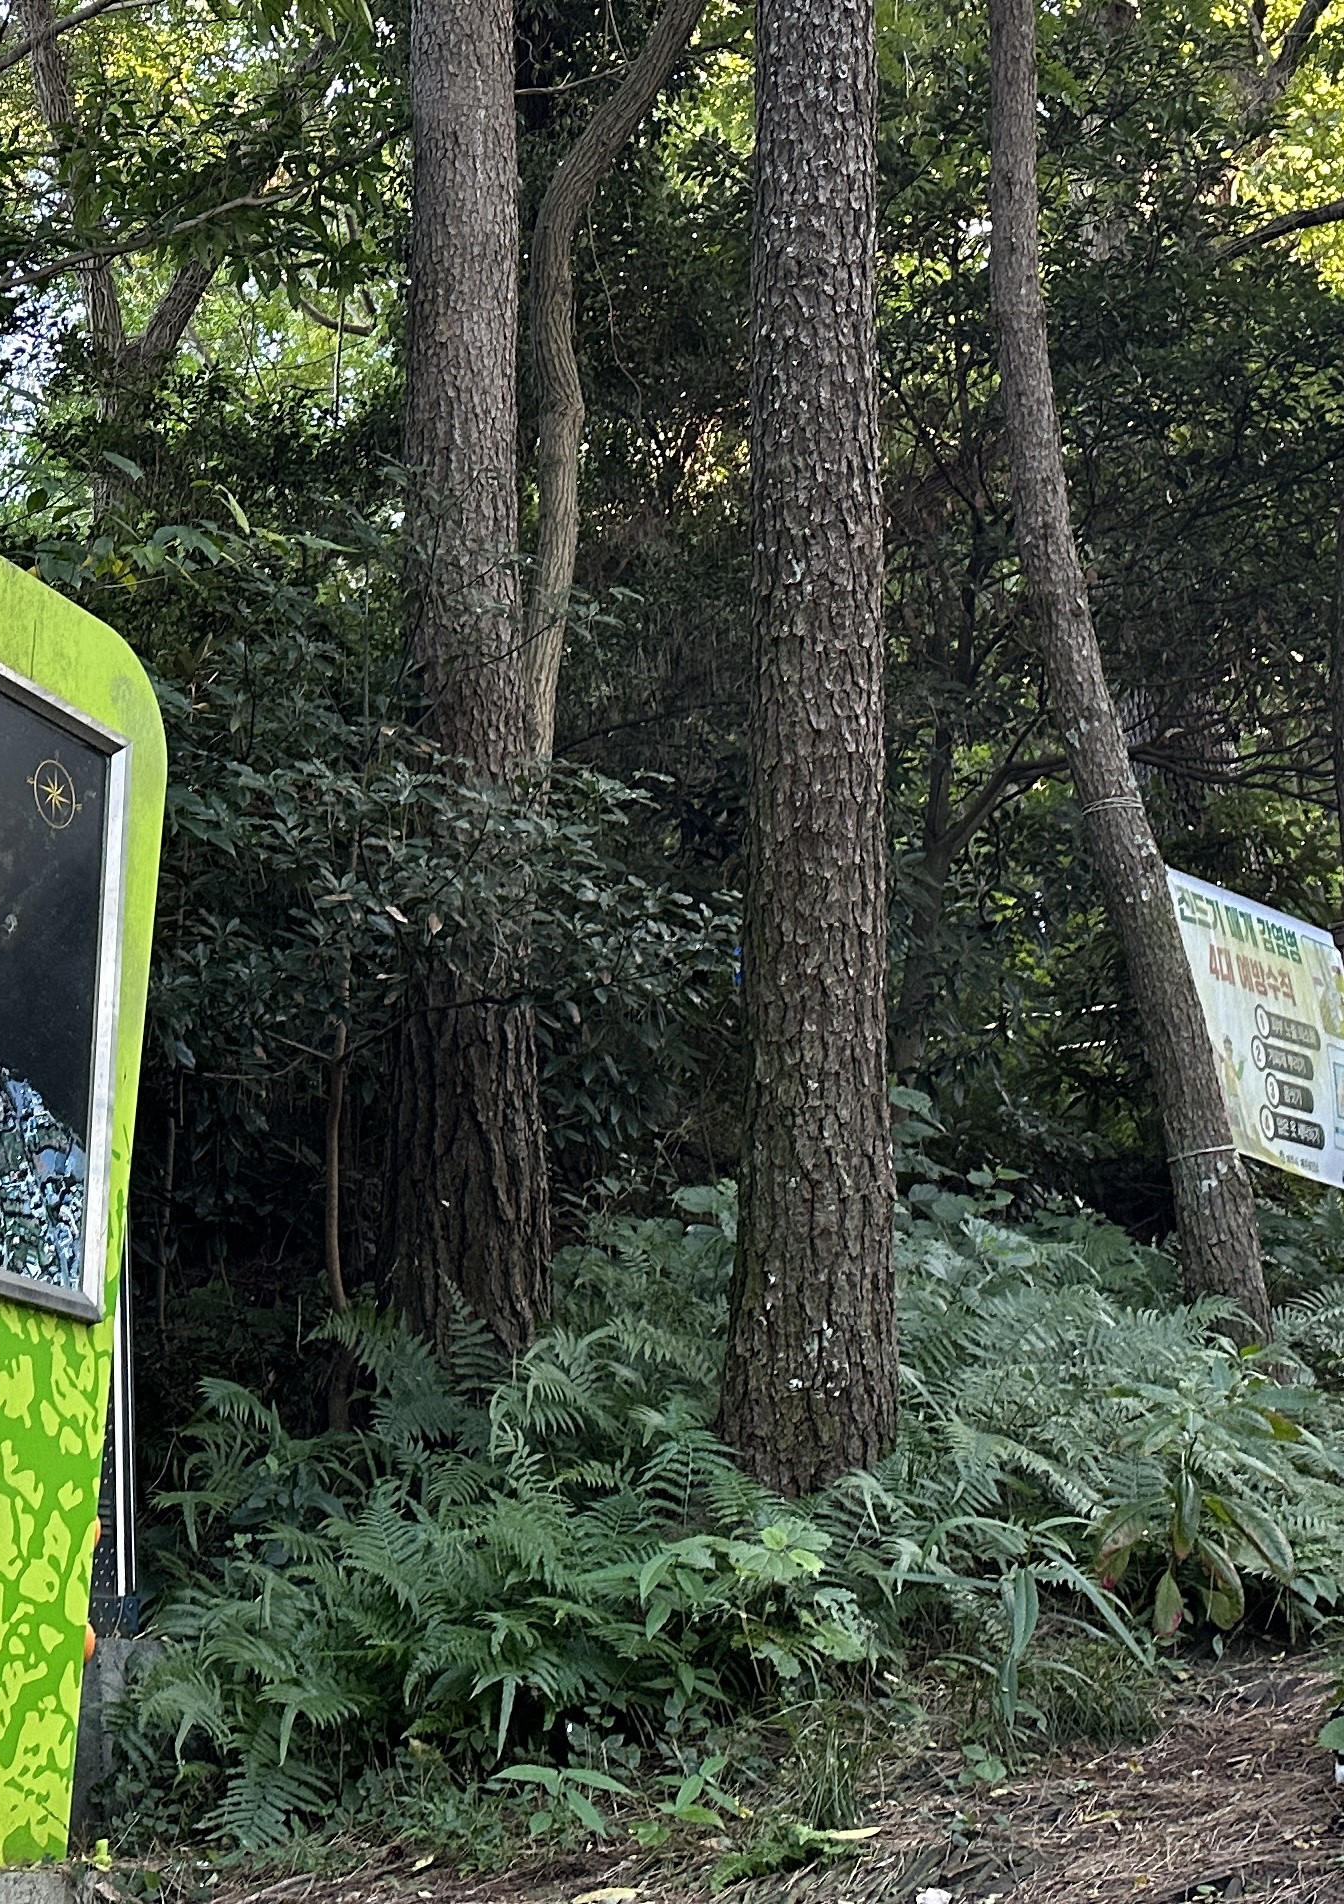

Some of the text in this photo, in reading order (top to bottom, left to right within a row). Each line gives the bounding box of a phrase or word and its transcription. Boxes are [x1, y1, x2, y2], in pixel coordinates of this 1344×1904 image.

[1175, 884, 1303, 965] 진드기 매개 감염병
[1209, 943, 1297, 1007] 4대 예방수칙
